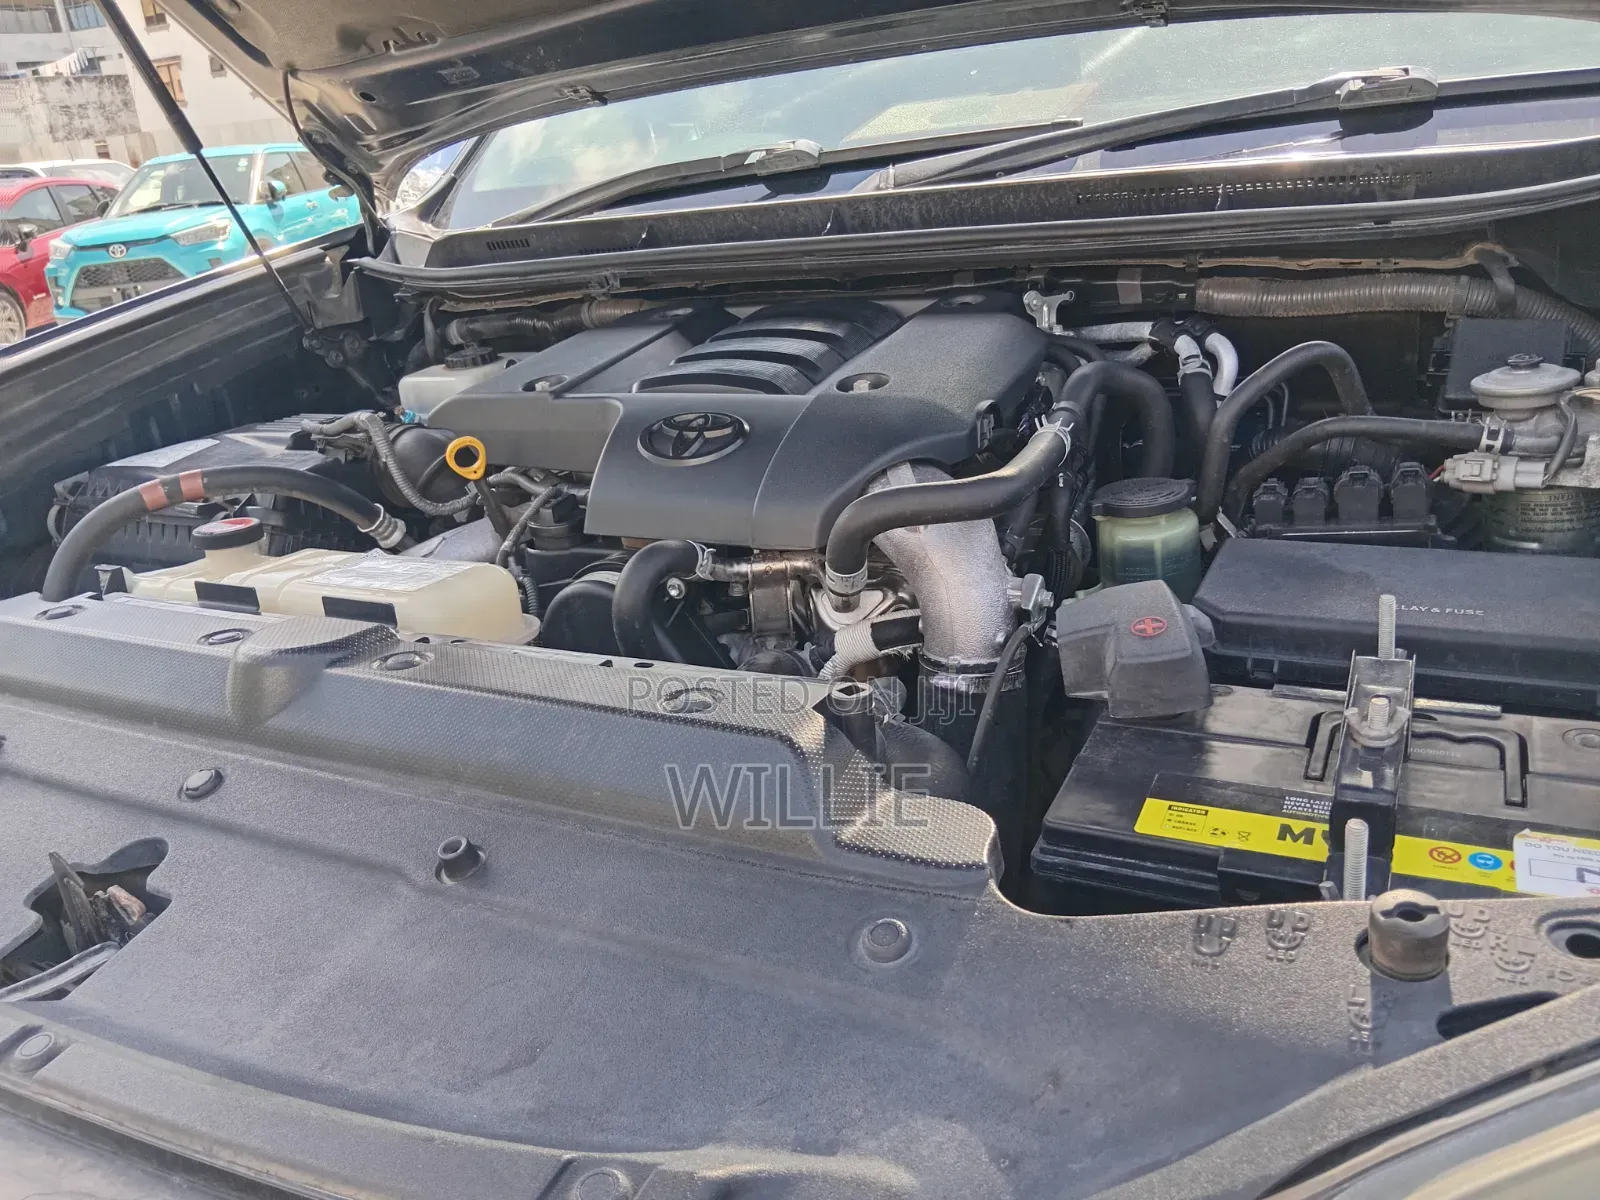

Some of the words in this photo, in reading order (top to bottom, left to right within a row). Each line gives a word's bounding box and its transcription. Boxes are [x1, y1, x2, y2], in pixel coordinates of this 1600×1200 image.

[1395, 604, 1429, 612] LAY
[1445, 608, 1485, 616] FUSE
[1170, 805, 1207, 815] INDICATOR
[1544, 844, 1570, 853] YOU
